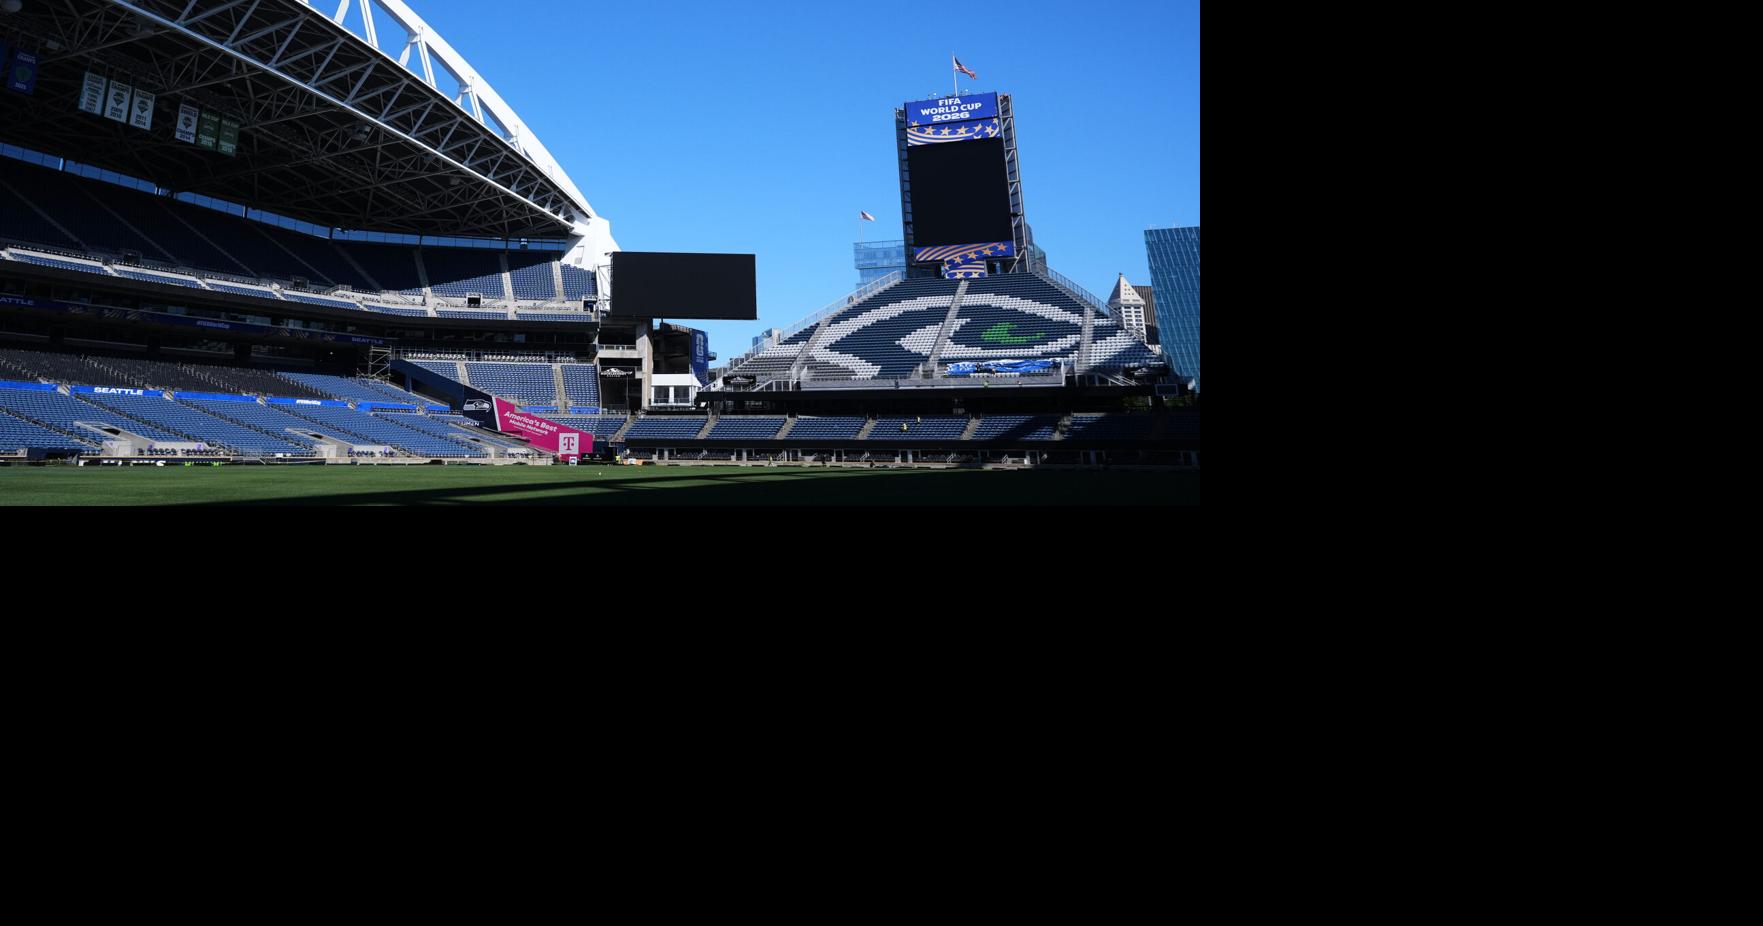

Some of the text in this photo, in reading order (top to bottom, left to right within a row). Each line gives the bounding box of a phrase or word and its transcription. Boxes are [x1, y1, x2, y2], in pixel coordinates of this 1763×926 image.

[938, 98, 961, 106] FIFA
[920, 102, 982, 115] WORLD CUP
[932, 111, 970, 122] 2026
[94, 386, 144, 396] SEATTLE
[503, 410, 540, 427] America's
[540, 422, 558, 432] Best
